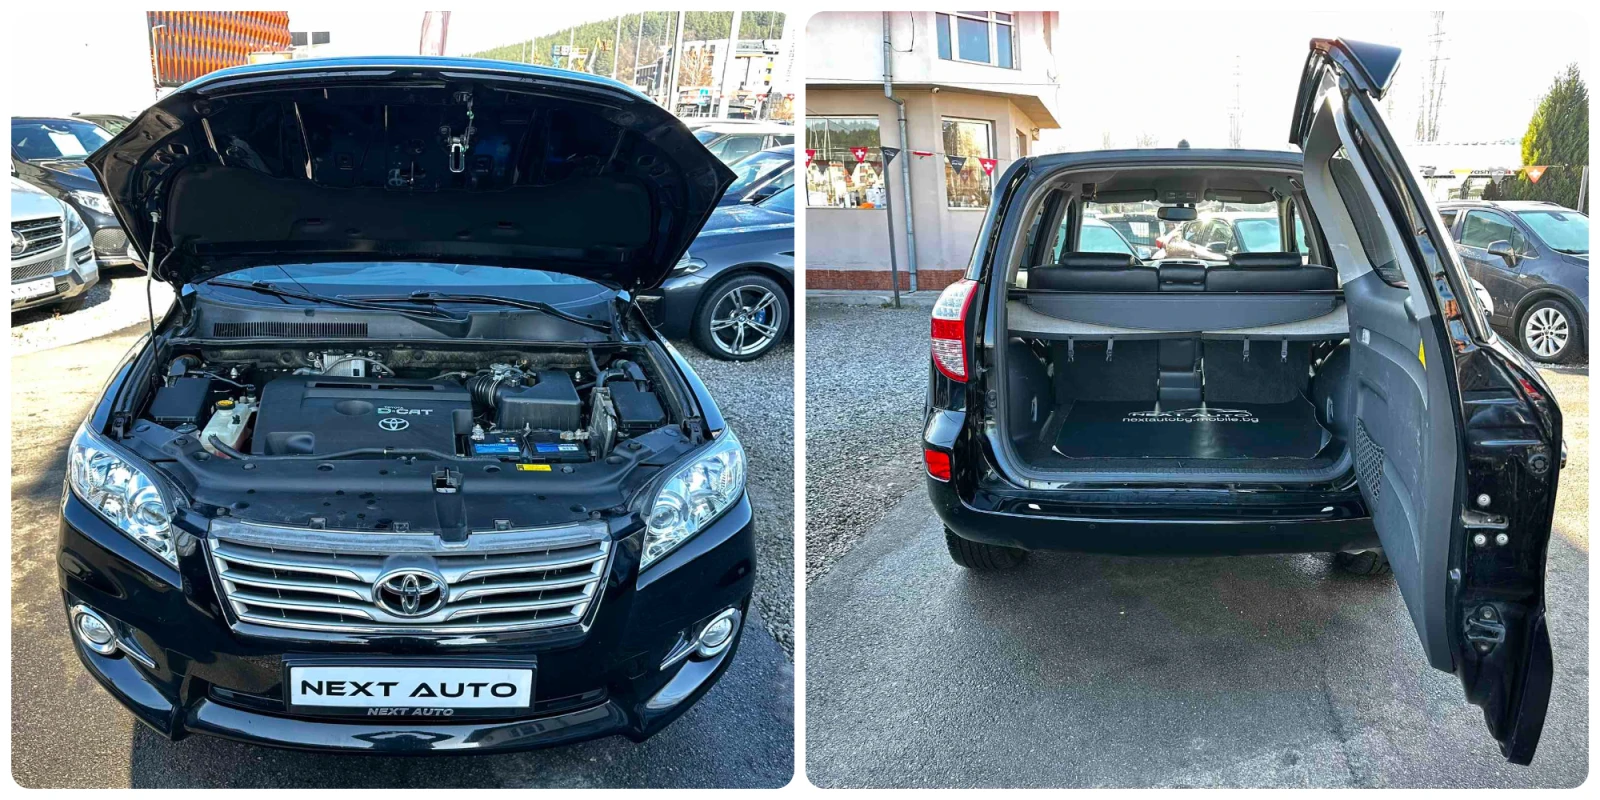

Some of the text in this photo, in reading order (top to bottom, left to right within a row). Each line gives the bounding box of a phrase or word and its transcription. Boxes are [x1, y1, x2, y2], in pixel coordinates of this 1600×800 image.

[301, 680, 518, 698] NEXT AUTO
[367, 707, 454, 716] NEXT AUTO
